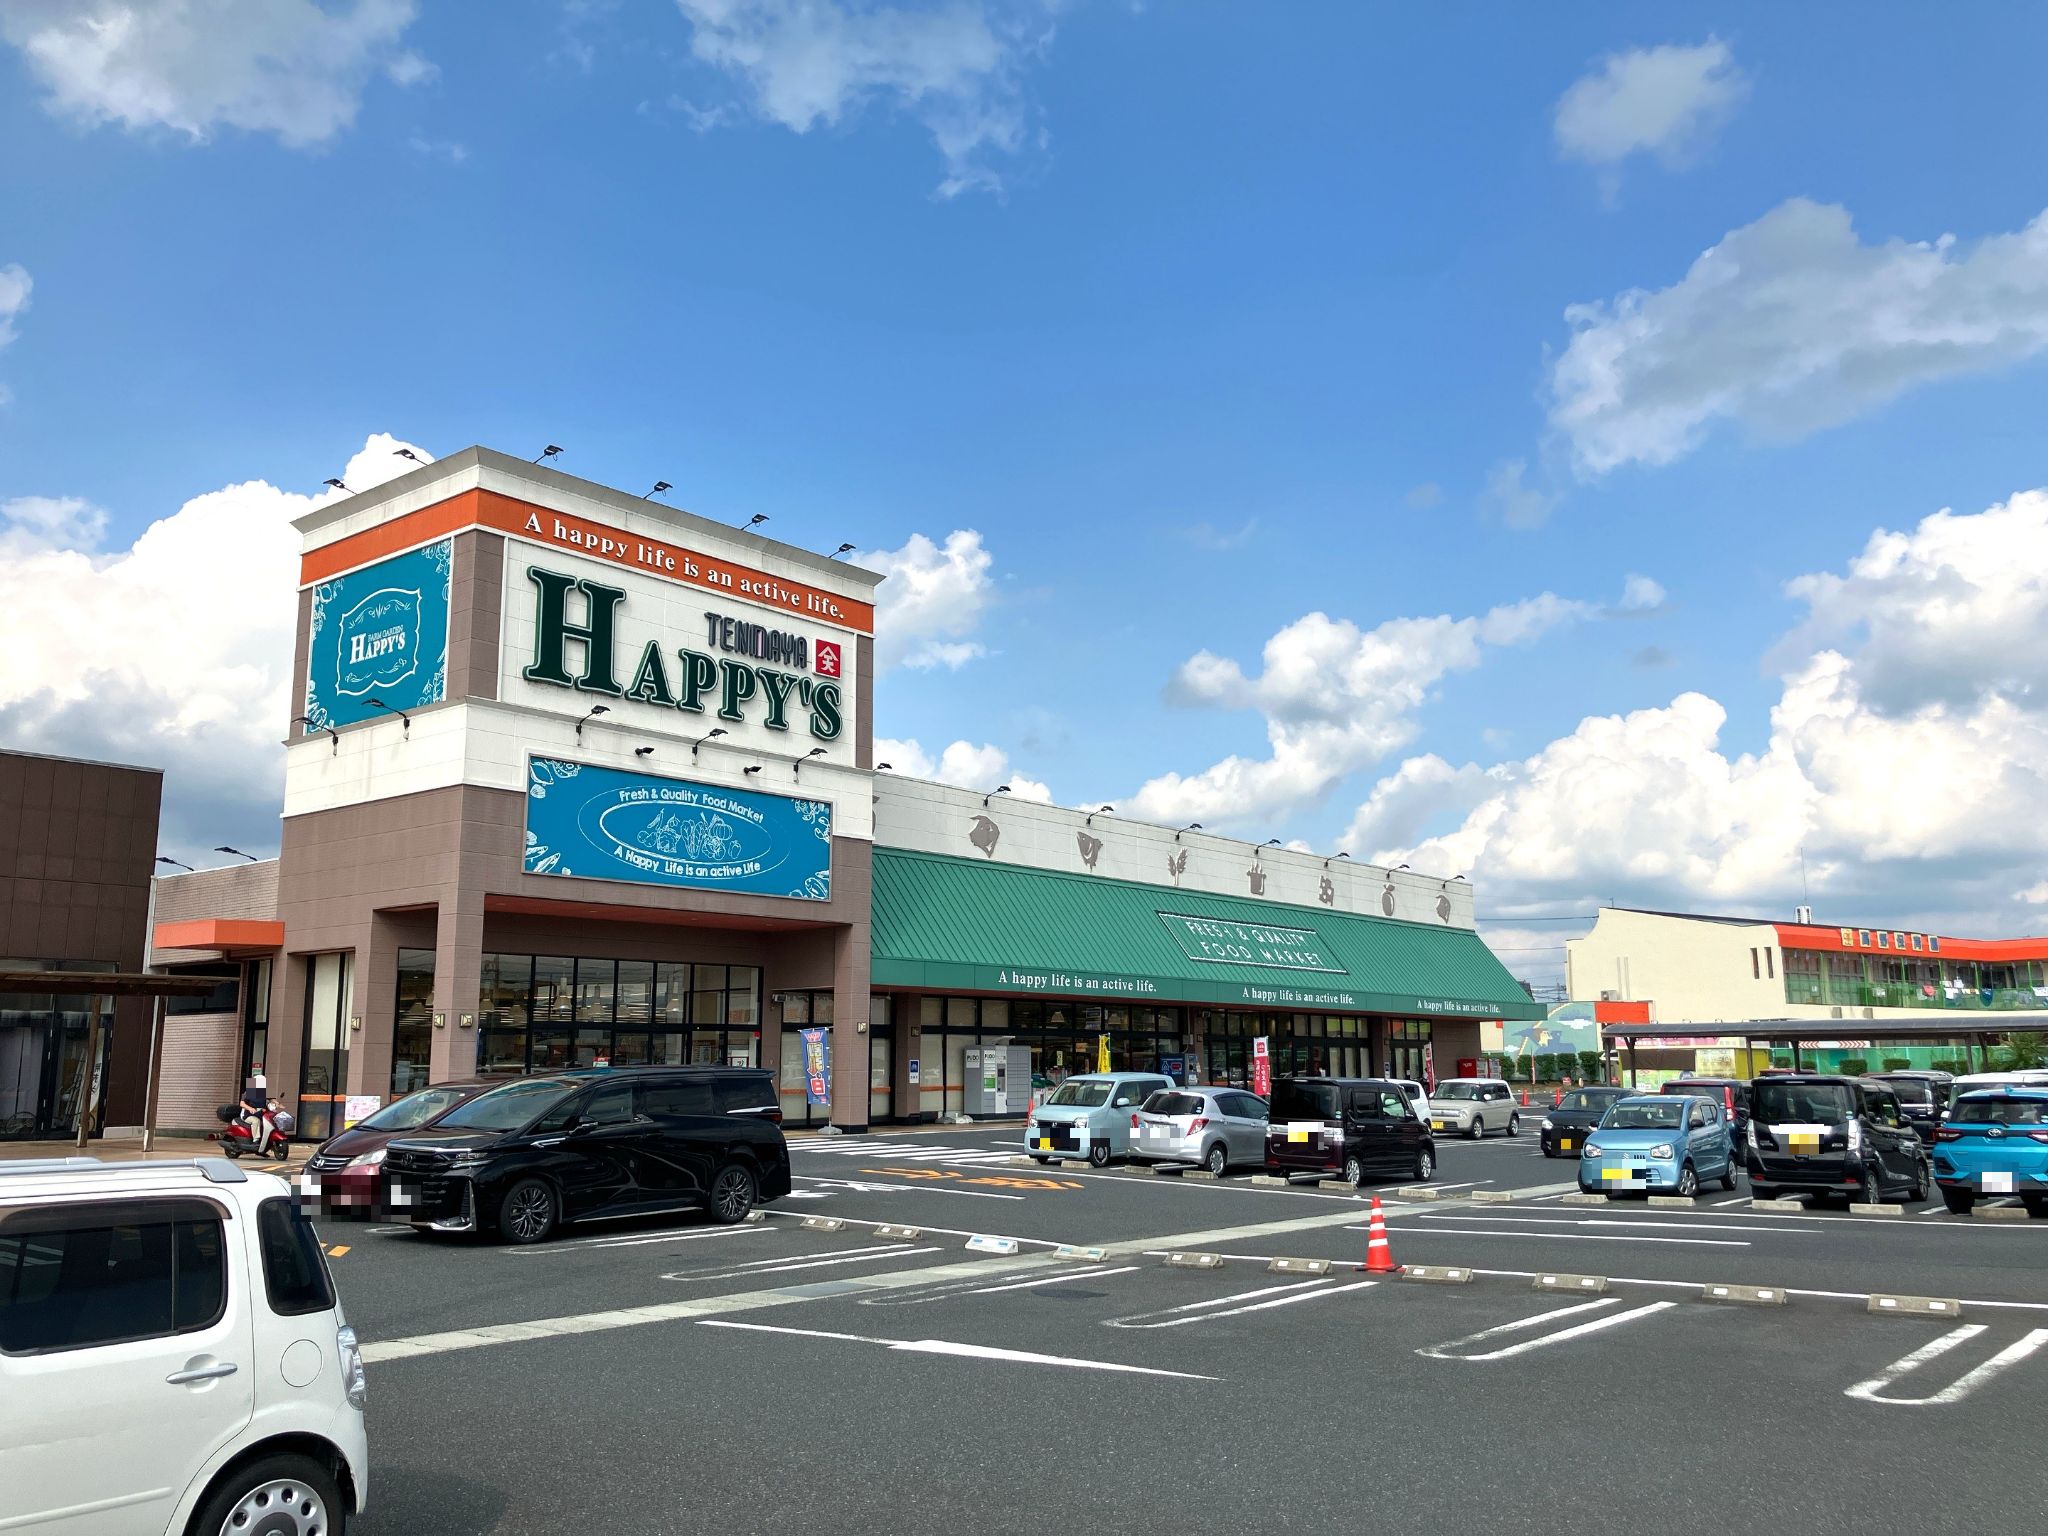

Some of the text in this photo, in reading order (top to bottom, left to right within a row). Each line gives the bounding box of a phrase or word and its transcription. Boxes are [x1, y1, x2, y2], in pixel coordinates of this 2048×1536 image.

[524, 512, 845, 619] A happy life is an active life.
[349, 632, 406, 665] HAPPY'S
[522, 565, 843, 741] HAPPY'S
[704, 611, 808, 669] TENMAYA
[619, 788, 764, 823] Fresh & Quality Food Market
[613, 845, 761, 878] A Happy Life is an active Life
[1236, 927, 1250, 941] &
[1200, 941, 1324, 967] FOOD MARKET
[998, 970, 1157, 992] A happy life is an active life.
[1242, 987, 1355, 1005] A happy life is an active life.
[1417, 1000, 1501, 1013] A happy life is an active life.
